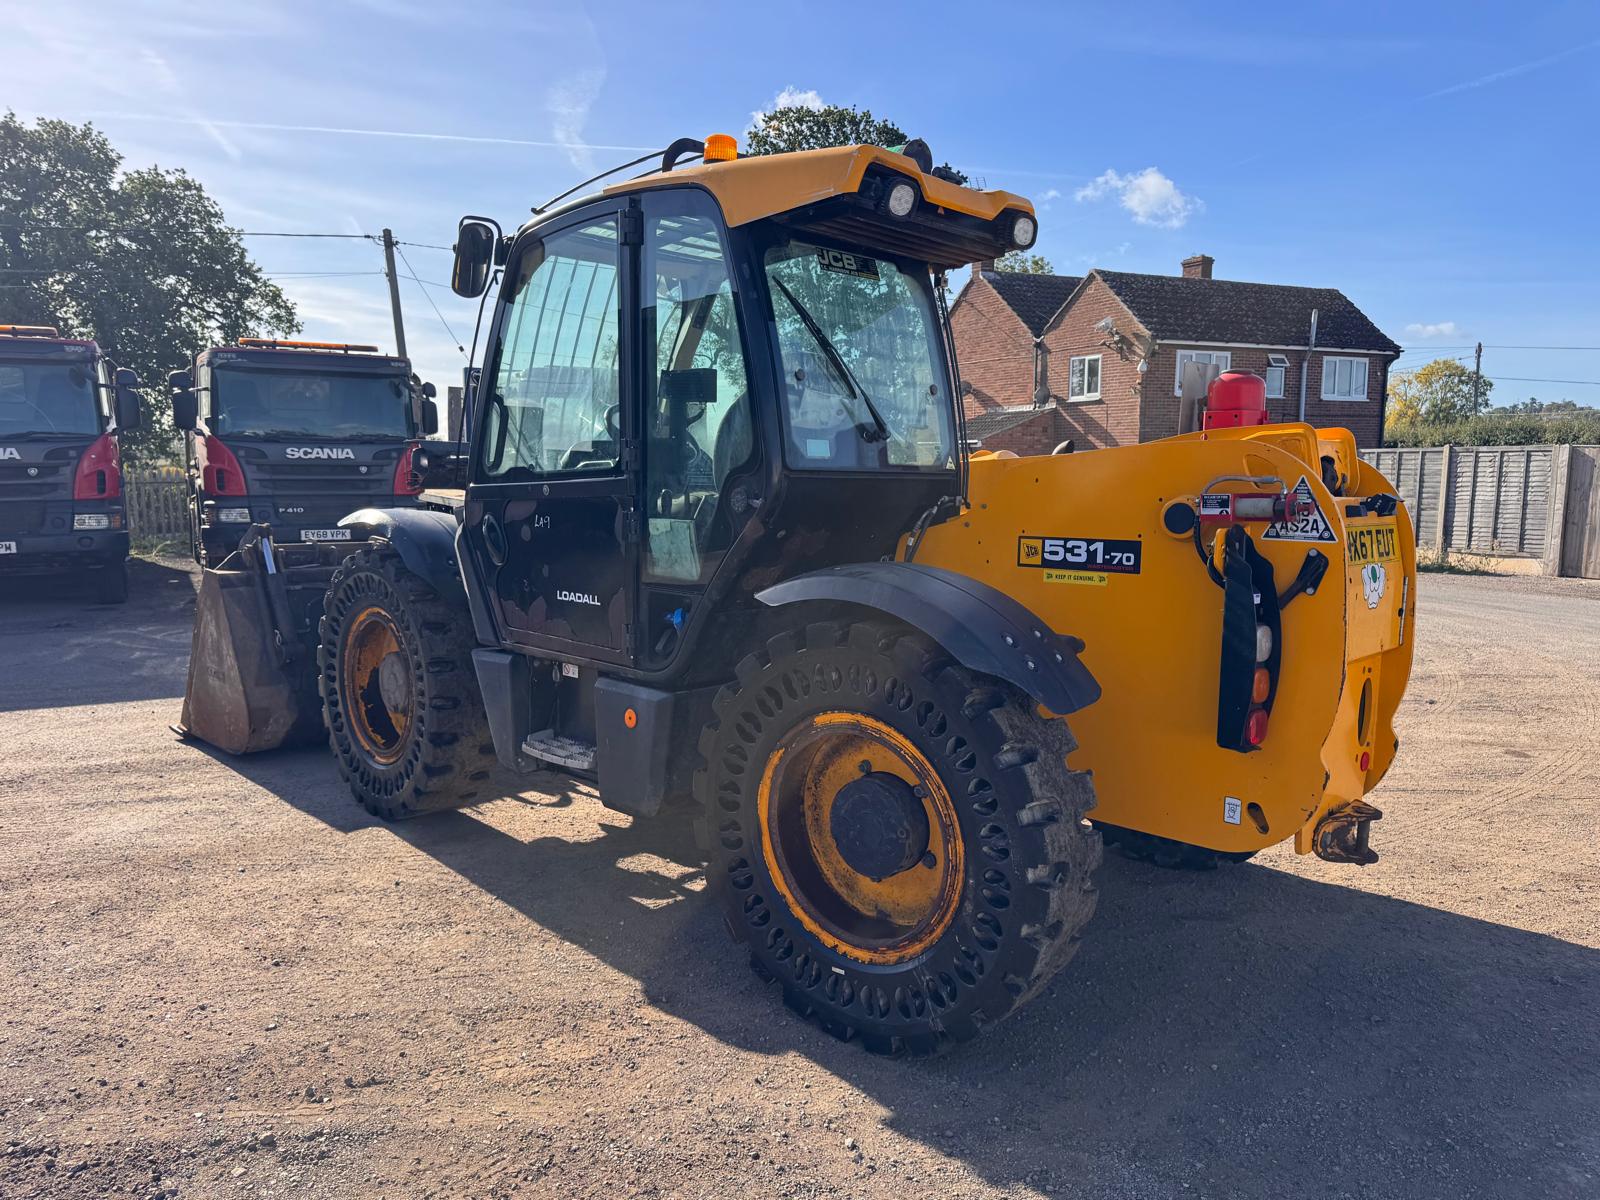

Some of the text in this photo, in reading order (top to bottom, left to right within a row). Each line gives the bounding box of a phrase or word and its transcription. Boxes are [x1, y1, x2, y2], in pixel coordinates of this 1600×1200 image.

[819, 250, 857, 270] JCB
[285, 447, 355, 459] SCANIA
[304, 530, 348, 539] EY68 VPK
[1375, 527, 1396, 558] EUT
[1025, 544, 1040, 558] JCB
[1055, 571, 1066, 580] KEEP
[1067, 572, 1072, 580] IT
[556, 590, 601, 605] LOADALL
